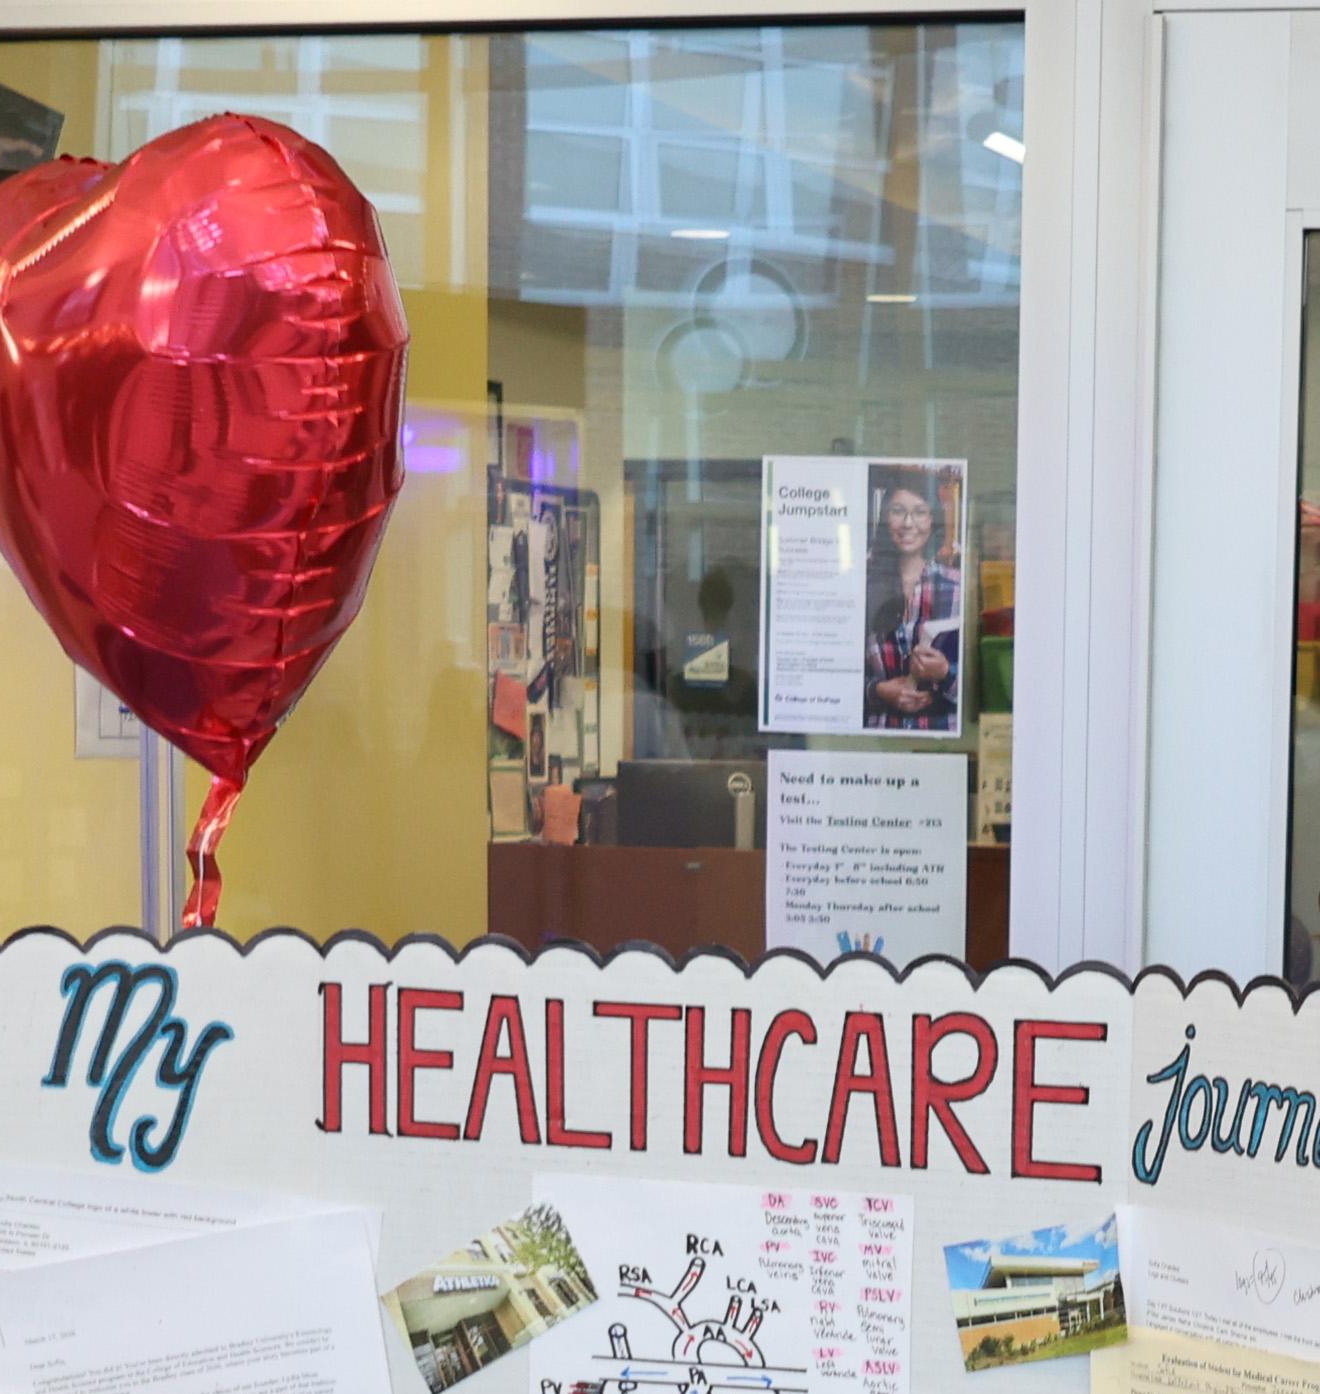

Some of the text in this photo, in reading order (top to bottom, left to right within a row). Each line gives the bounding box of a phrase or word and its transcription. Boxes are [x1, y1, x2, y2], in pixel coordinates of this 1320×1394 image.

[779, 486, 830, 502] College
[778, 505, 848, 519] Jumpstart
[780, 772, 920, 789] Need to make up a
[826, 816, 868, 828] Testing
[872, 817, 912, 828] Center
[40, 959, 234, 1174] My
[314, 981, 1108, 1185] HEALTHCARE
[686, 1234, 724, 1257] RCA
[618, 1265, 653, 1285] RSA
[726, 1276, 757, 1294] LCA
[863, 1288, 896, 1301] PSLV
[751, 1295, 781, 1314] LSA
[702, 1325, 728, 1343] AA
[688, 1367, 708, 1385] PA
